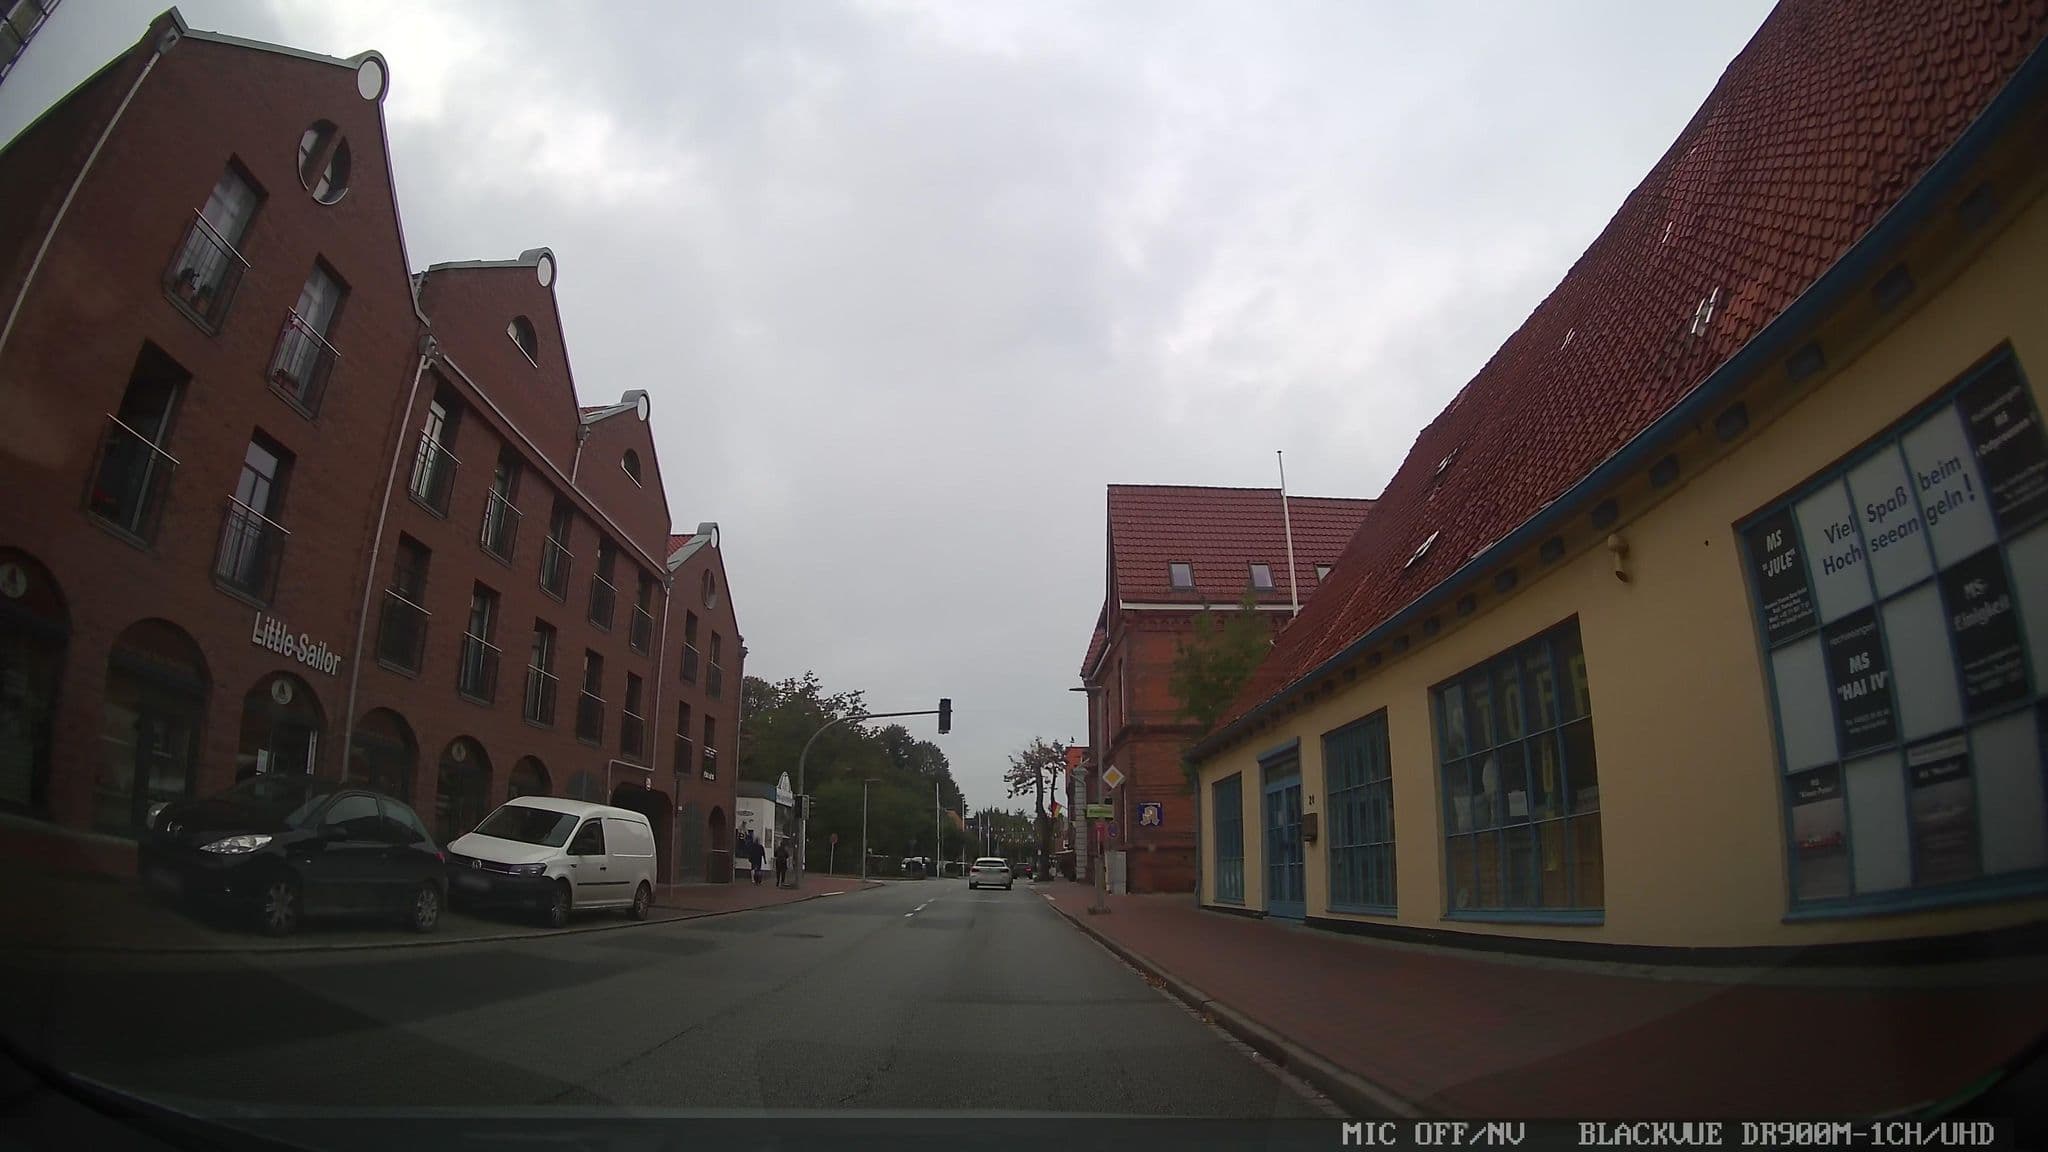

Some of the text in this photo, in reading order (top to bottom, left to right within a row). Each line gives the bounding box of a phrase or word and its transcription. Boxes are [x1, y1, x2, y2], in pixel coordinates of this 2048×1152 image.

[1824, 515, 1855, 544] Viel
[1866, 487, 1907, 524] Spaß
[1917, 455, 1962, 491] beim
[1766, 529, 1782, 553] MS
[252, 610, 342, 676] Little Sailor
[1848, 651, 1870, 674] MS
